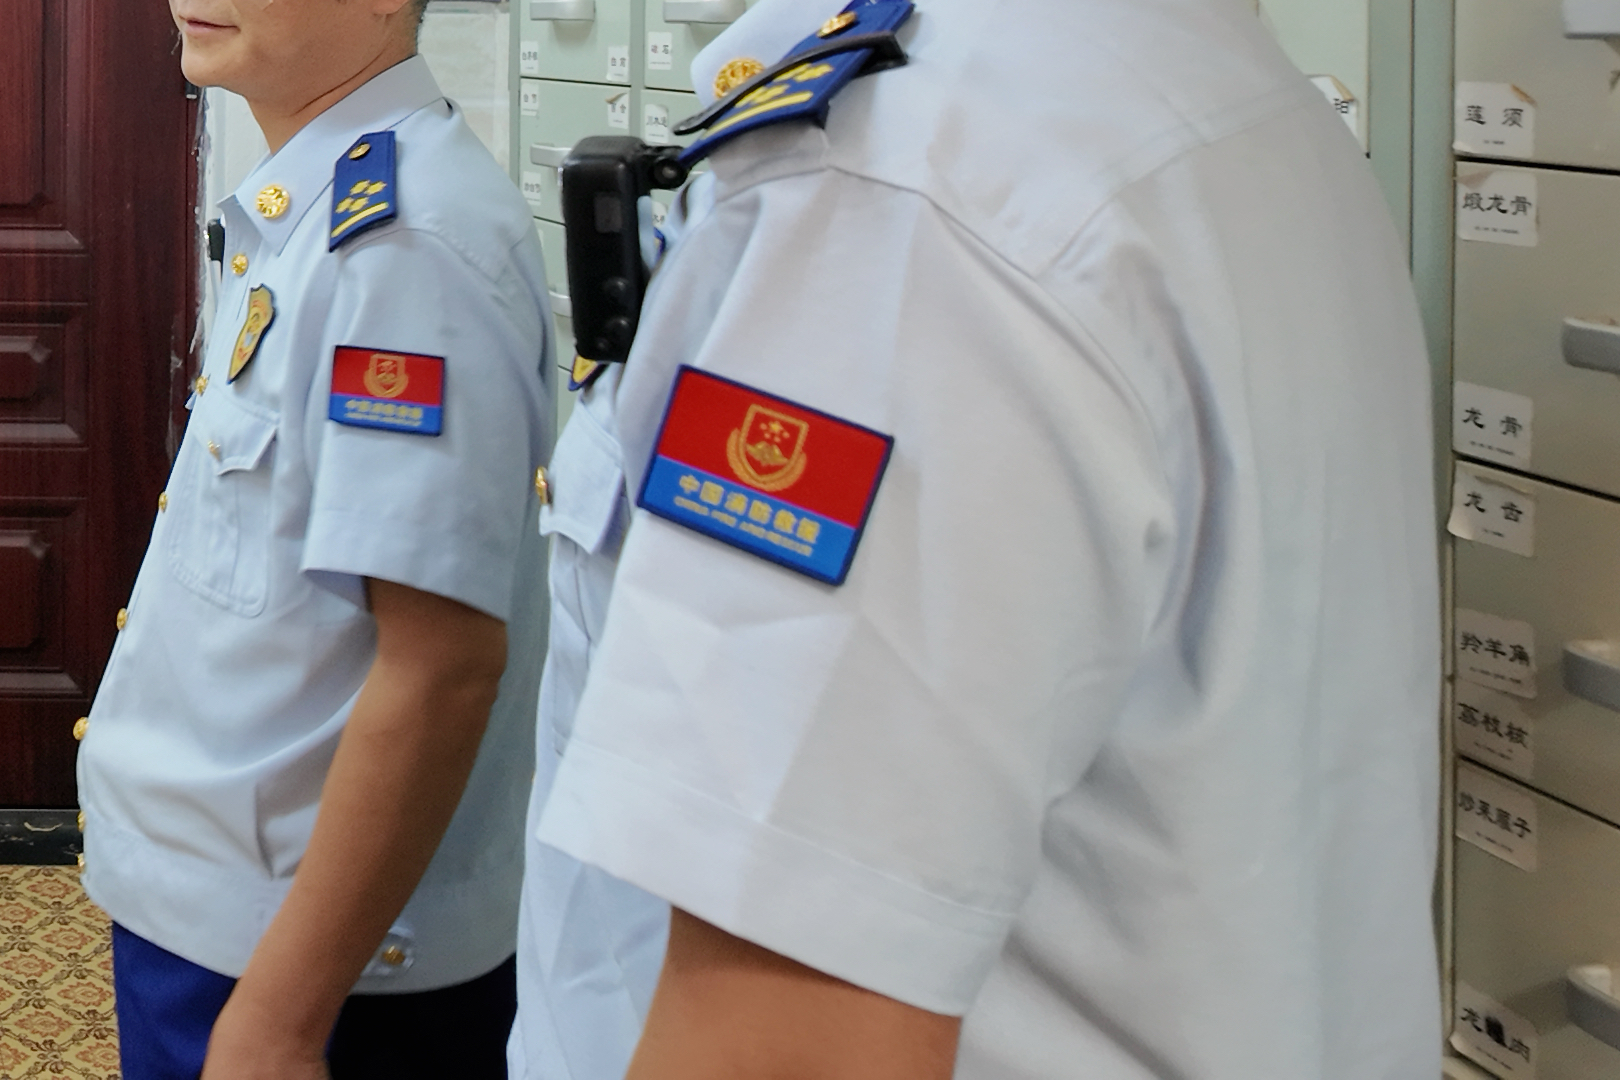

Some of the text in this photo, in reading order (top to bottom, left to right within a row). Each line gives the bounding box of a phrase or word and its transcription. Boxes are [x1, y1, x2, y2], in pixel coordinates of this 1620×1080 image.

[1465, 105, 1525, 128] 莲须
[1463, 192, 1532, 217] 煅龙骨
[1464, 407, 1523, 436] 龙骨
[1464, 491, 1523, 524] 龙齿
[1461, 631, 1530, 668] 羚羊角
[1459, 702, 1528, 748] 荔枝核
